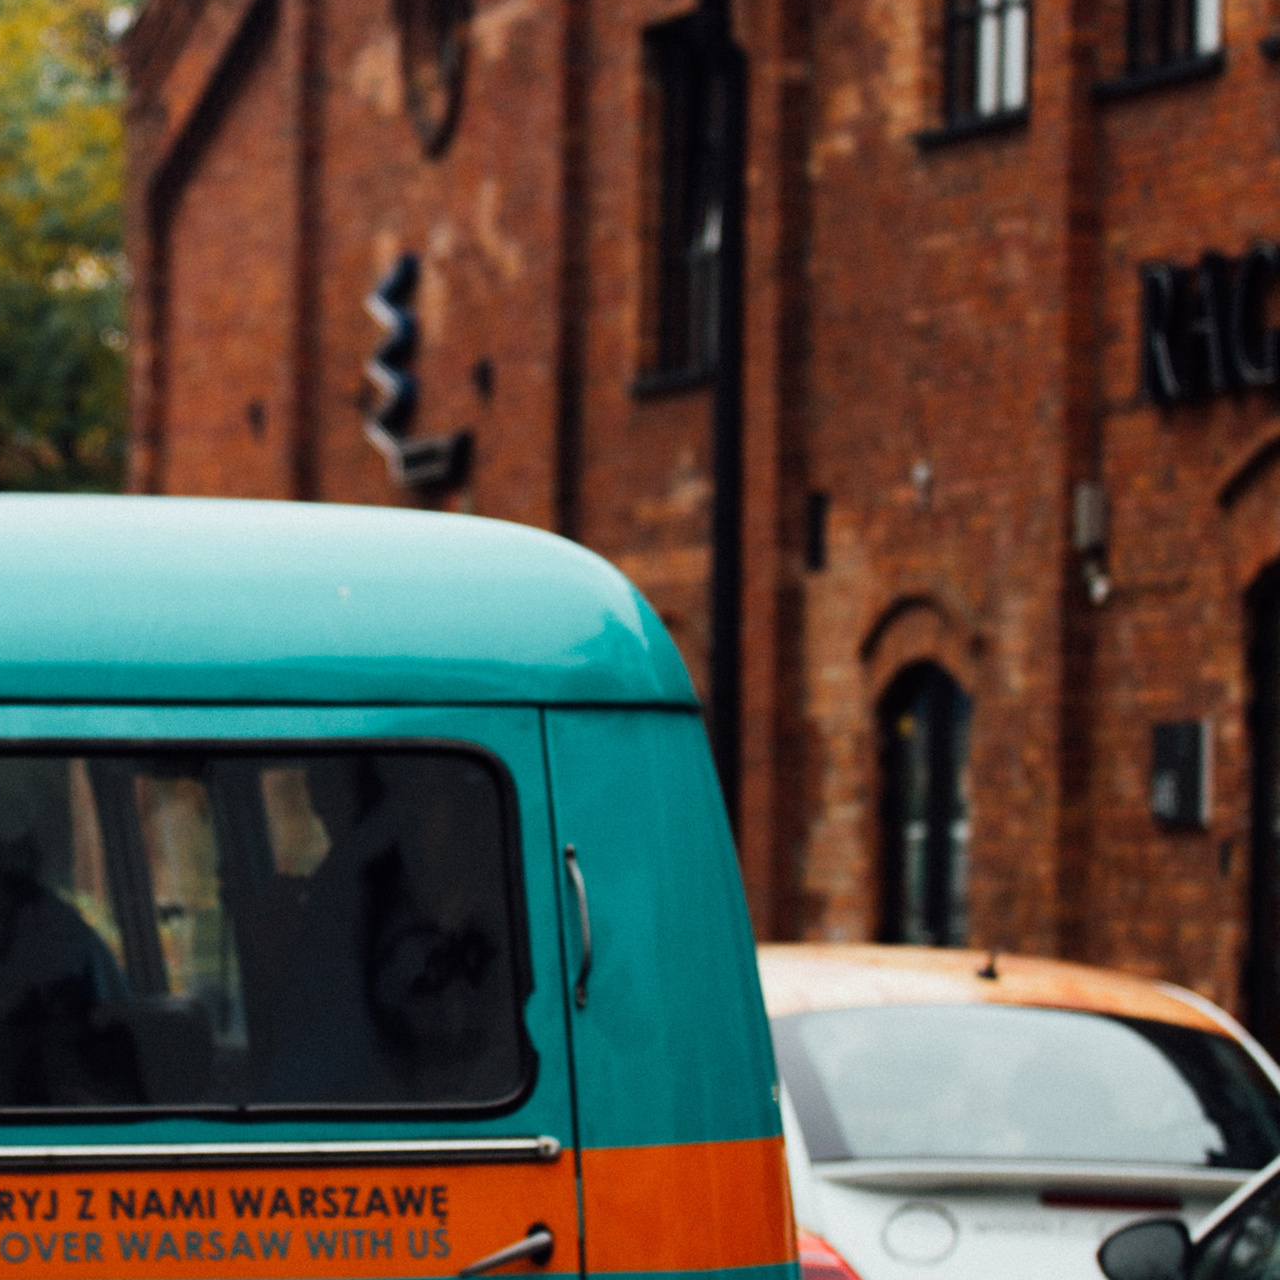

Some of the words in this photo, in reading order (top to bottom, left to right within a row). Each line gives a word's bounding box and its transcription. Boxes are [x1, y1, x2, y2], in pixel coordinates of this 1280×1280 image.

[76, 1188, 95, 1220] Z
[109, 1187, 215, 1219] NAMI
[229, 1185, 449, 1225] WARSZAWĘ
[117, 1229, 291, 1261] WARSAW
[304, 1228, 393, 1259] WITH
[407, 1226, 451, 1259] US
